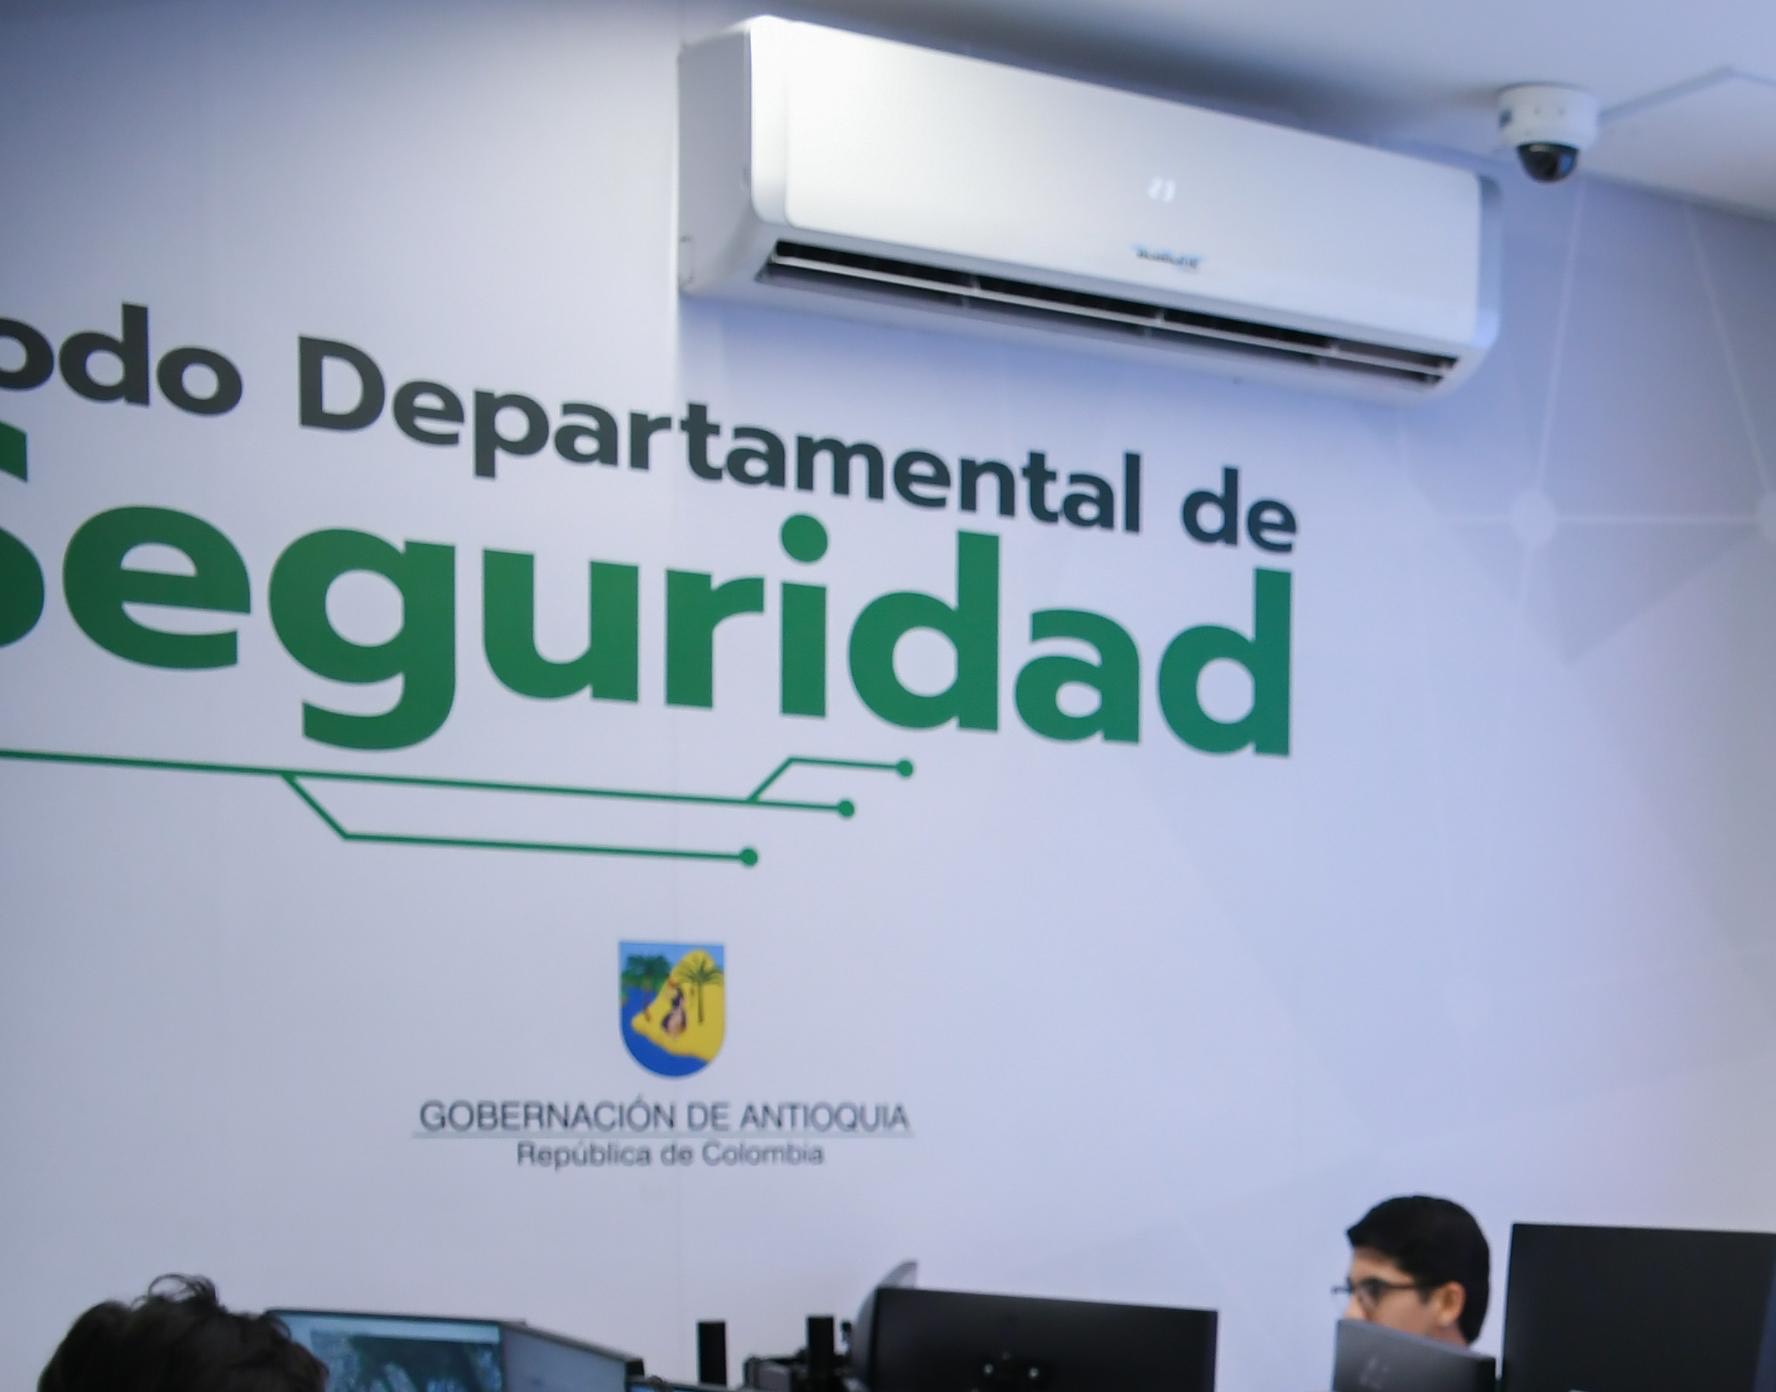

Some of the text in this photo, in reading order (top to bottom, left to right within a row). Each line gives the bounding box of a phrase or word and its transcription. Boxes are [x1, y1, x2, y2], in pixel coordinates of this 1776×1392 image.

[298, 335, 1143, 535] Departamental
[1181, 466, 1298, 554] de
[0, 419, 1292, 757] eguridad
[420, 1096, 910, 1133] GOBERNACIÓN DE ANTIOQUIA
[517, 1139, 825, 1171] República de Colombia
